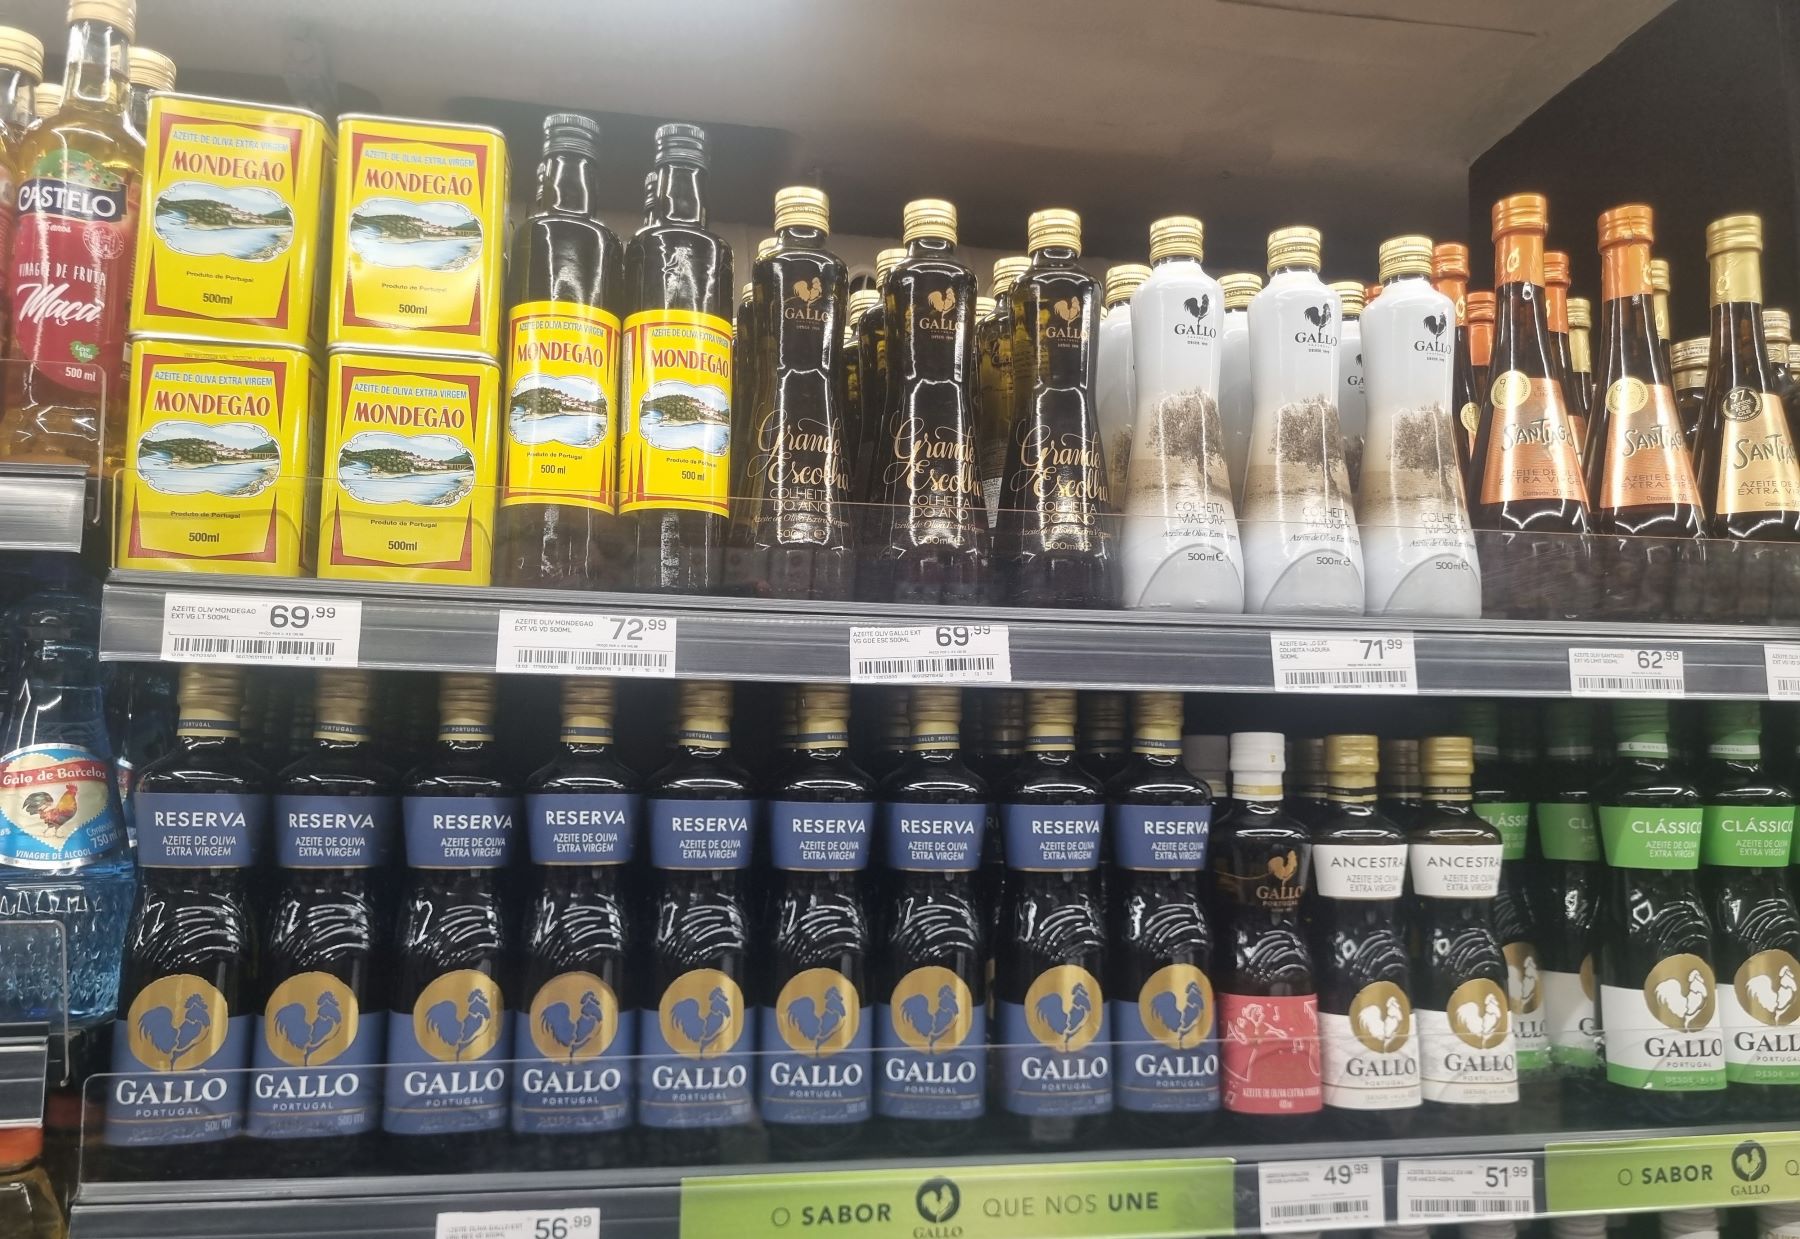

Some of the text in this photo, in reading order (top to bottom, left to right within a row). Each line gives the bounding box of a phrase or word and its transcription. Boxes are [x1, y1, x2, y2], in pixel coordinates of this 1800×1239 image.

[18, 186, 116, 217] CASTELO
[56, 264, 67, 278] DE
[73, 265, 107, 287] FRUTA
[202, 292, 233, 305] 500ml
[399, 304, 427, 315] 500ml
[784, 307, 830, 323] GALLO
[1046, 326, 1088, 340] GALLO
[1174, 323, 1217, 338] GALLO
[1295, 331, 1338, 346] GALLO
[1414, 340, 1451, 355] GALLO
[154, 371, 272, 386] AZEITE DE OLIVA EXTRA VIRGEM
[354, 383, 467, 399] AZEITE DE OLIVA EXTRA VIRGEM
[890, 410, 975, 464] Grande
[1016, 419, 1101, 469] Grande
[747, 451, 850, 492] Escolha
[884, 460, 985, 498] Escolha
[1010, 466, 1111, 505] Escolha
[188, 532, 220, 543] 500ml
[388, 540, 417, 551] 500ml
[214, 607, 256, 615] MONDEGAO
[270, 605, 336, 629] 69,99
[610, 618, 667, 641] 72,99
[936, 625, 991, 646] 69,99
[1360, 639, 1403, 659] 71,99
[1637, 651, 1679, 668] 62,99
[3, 767, 106, 785] Galo de Barcelos
[155, 811, 246, 827] RESERVA
[289, 813, 375, 829] RESERVA
[433, 814, 512, 830] RESERVA
[546, 810, 625, 825] RESERVA
[672, 817, 748, 832] RESERVA
[792, 818, 866, 833] RESERVA
[901, 819, 975, 834] RESERVA
[1032, 820, 1099, 834] RESERVA
[1144, 821, 1209, 835] RESERVA
[1632, 819, 1701, 834] CLÁSSICO
[1722, 818, 1793, 833] CLÁSSICO
[163, 835, 236, 845] AZEITE DE OLIVA
[296, 837, 365, 847] AZEITE DE OLIVA
[440, 837, 506, 847] AZEITE DE OLIVA
[553, 833, 618, 843] AZEITE DE OLIVA
[679, 839, 741, 849] AZEITE DE OLIVA
[800, 840, 859, 850] AZEITE DE OLIVA
[166, 847, 231, 857] EXTRA VIRGEM
[299, 847, 360, 857] EXTRA VIRGEM
[444, 848, 502, 857] EXTRA VIRGEM
[557, 843, 613, 853] EXTRA VIRGEM
[908, 841, 968, 851] AZEITE DE OLIVA
[16, 850, 49, 859] VINAGRE
[682, 850, 737, 859] EXTRA VIRGEM
[803, 851, 855, 860] EXTRA VIRGEM
[911, 851, 964, 860] EXTRA VIRGEM
[1043, 851, 1092, 860] EXTRA VIRGEM
[1256, 885, 1304, 900] GALLO
[1644, 1036, 1723, 1058] GALLO
[1021, 1057, 1108, 1081] GALLO
[1135, 1054, 1219, 1077] GALLO
[1346, 1058, 1416, 1076] GALLO
[1444, 1053, 1514, 1072] GALLO
[1666, 1061, 1712, 1069] PORTUGAL
[652, 1064, 747, 1091] GALLO
[770, 1062, 863, 1087] GALLO
[885, 1058, 976, 1084] GALLO
[255, 1073, 359, 1099] GALLO
[403, 1068, 504, 1096] GALLO
[522, 1068, 621, 1094] GALLO
[116, 1077, 228, 1106] GALLO
[672, 1092, 727, 1101] PORTUGAL
[789, 1090, 843, 1098] PORTUGAL
[904, 1085, 957, 1095] PORTUGAL
[272, 1101, 334, 1111] PORTUGAL
[426, 1096, 484, 1107] PORTUGAL
[542, 1096, 599, 1105] PORTUGAL
[136, 1108, 200, 1118] PORTUGAL
[1618, 1168, 1633, 1186] O
[1642, 1165, 1713, 1185] SABOR
[1731, 1184, 1770, 1196] GALLO
[771, 1191, 1159, 1227] O SABOR QUE NOS UNE
[913, 1225, 963, 1239] GALLO
